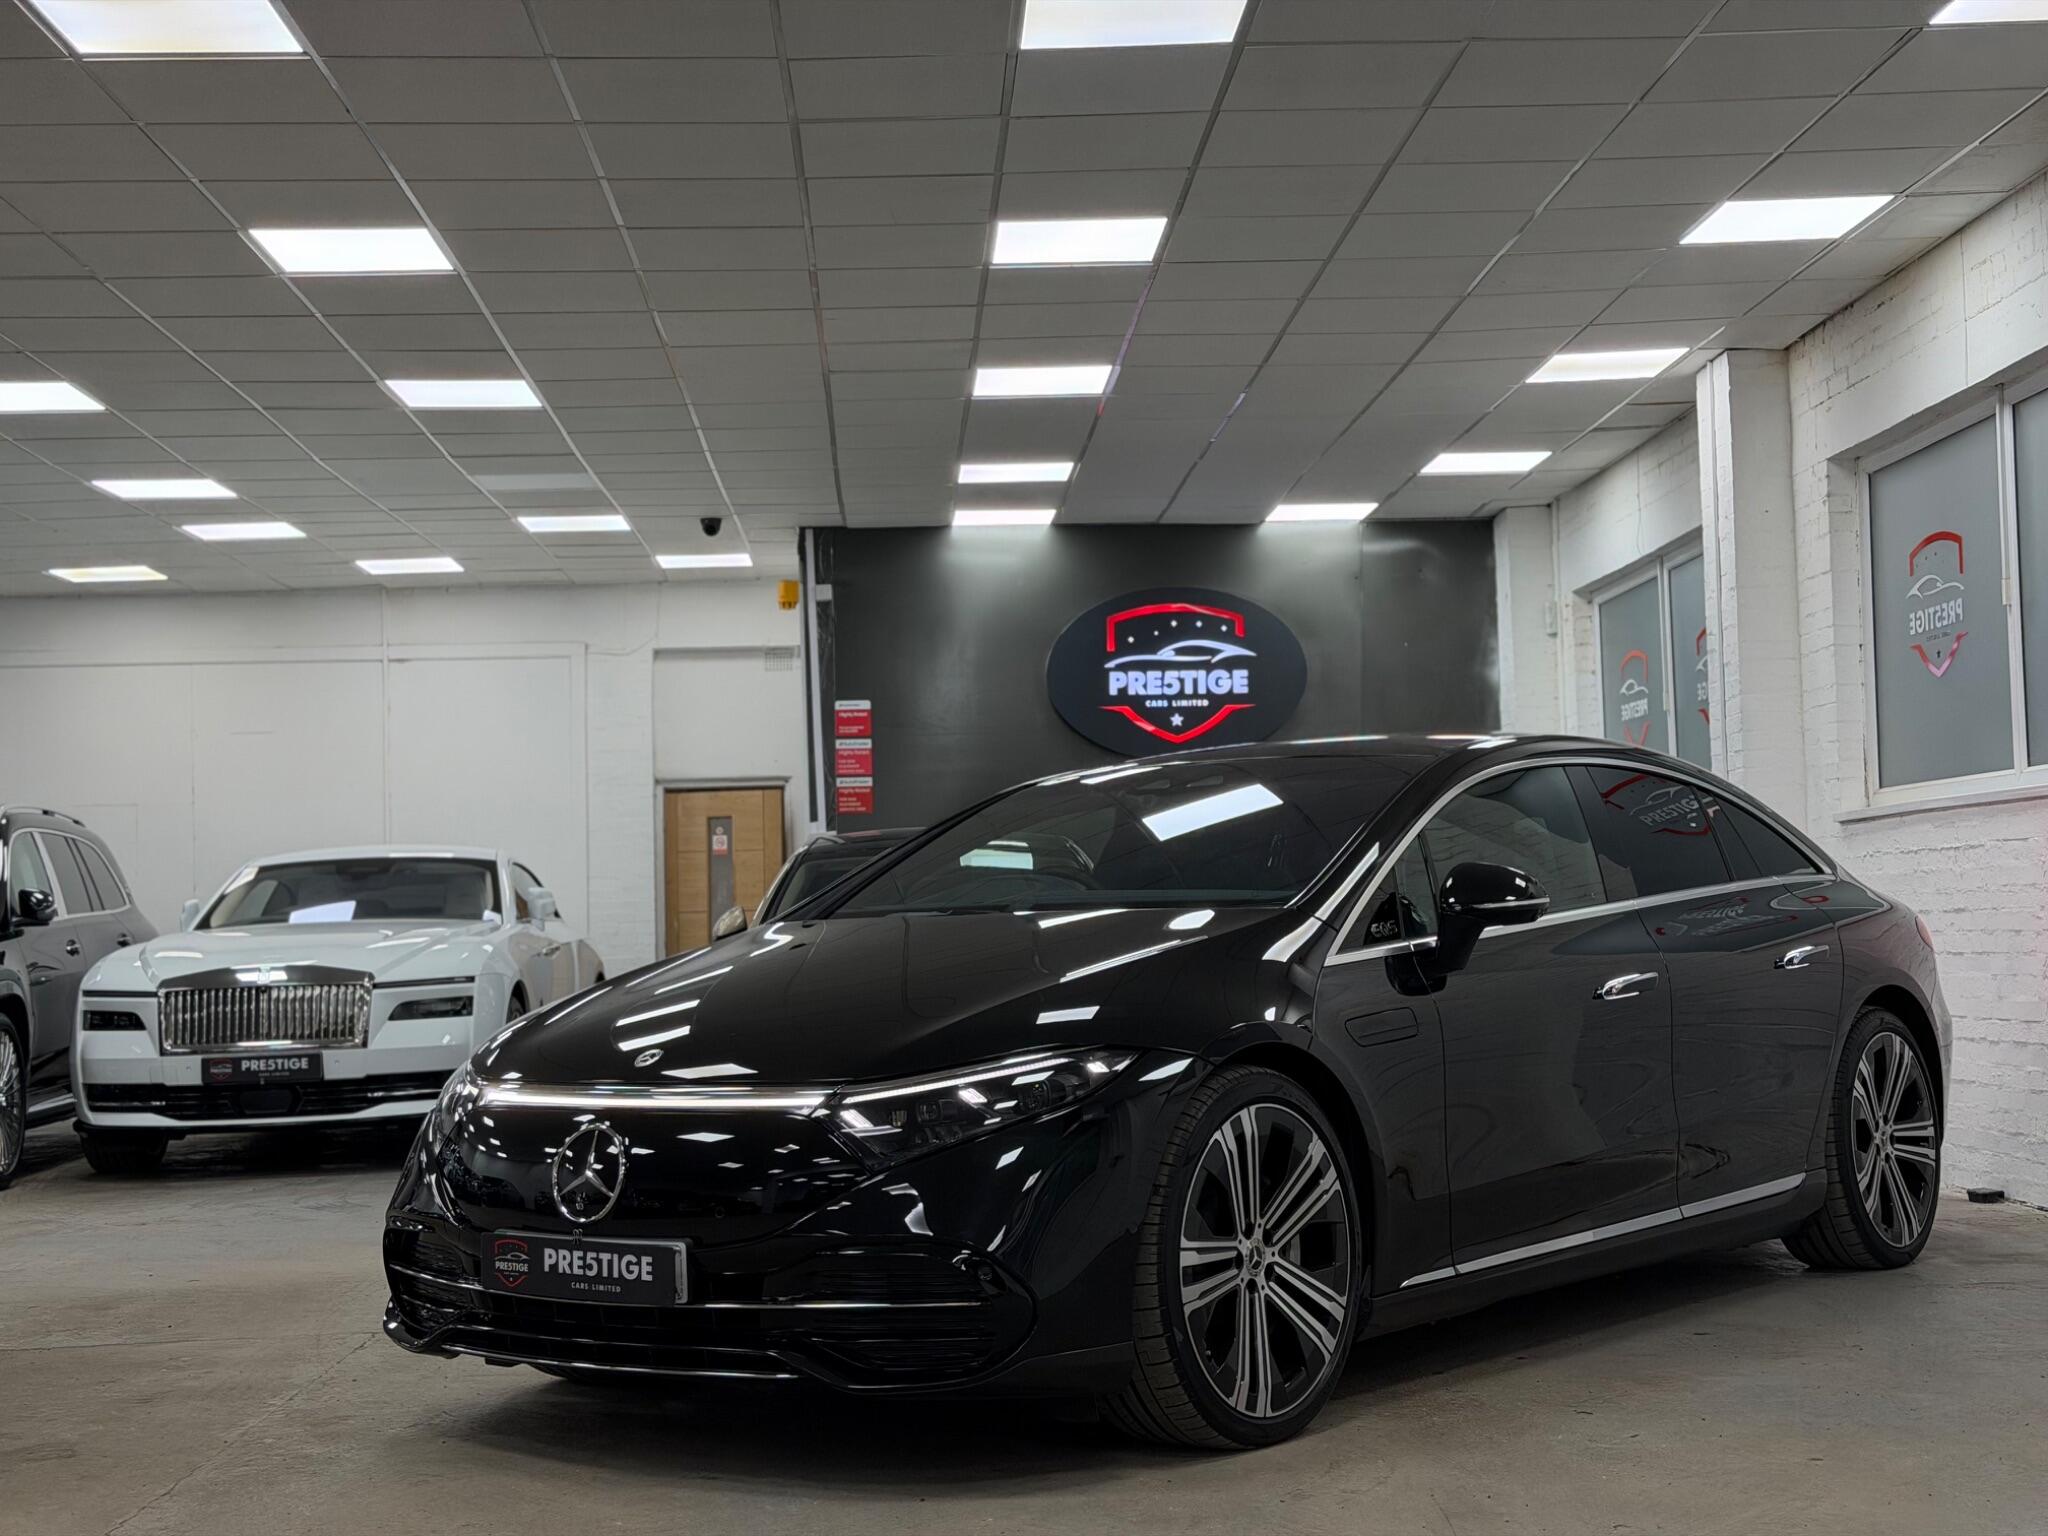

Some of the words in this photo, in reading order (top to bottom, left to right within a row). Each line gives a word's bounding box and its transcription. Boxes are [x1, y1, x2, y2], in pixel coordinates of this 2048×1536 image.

[1145, 699, 1168, 708] CARS
[1172, 699, 1209, 708] LIMITED
[571, 1281, 589, 1290] CARS
[592, 1283, 621, 1293] LIMITED
